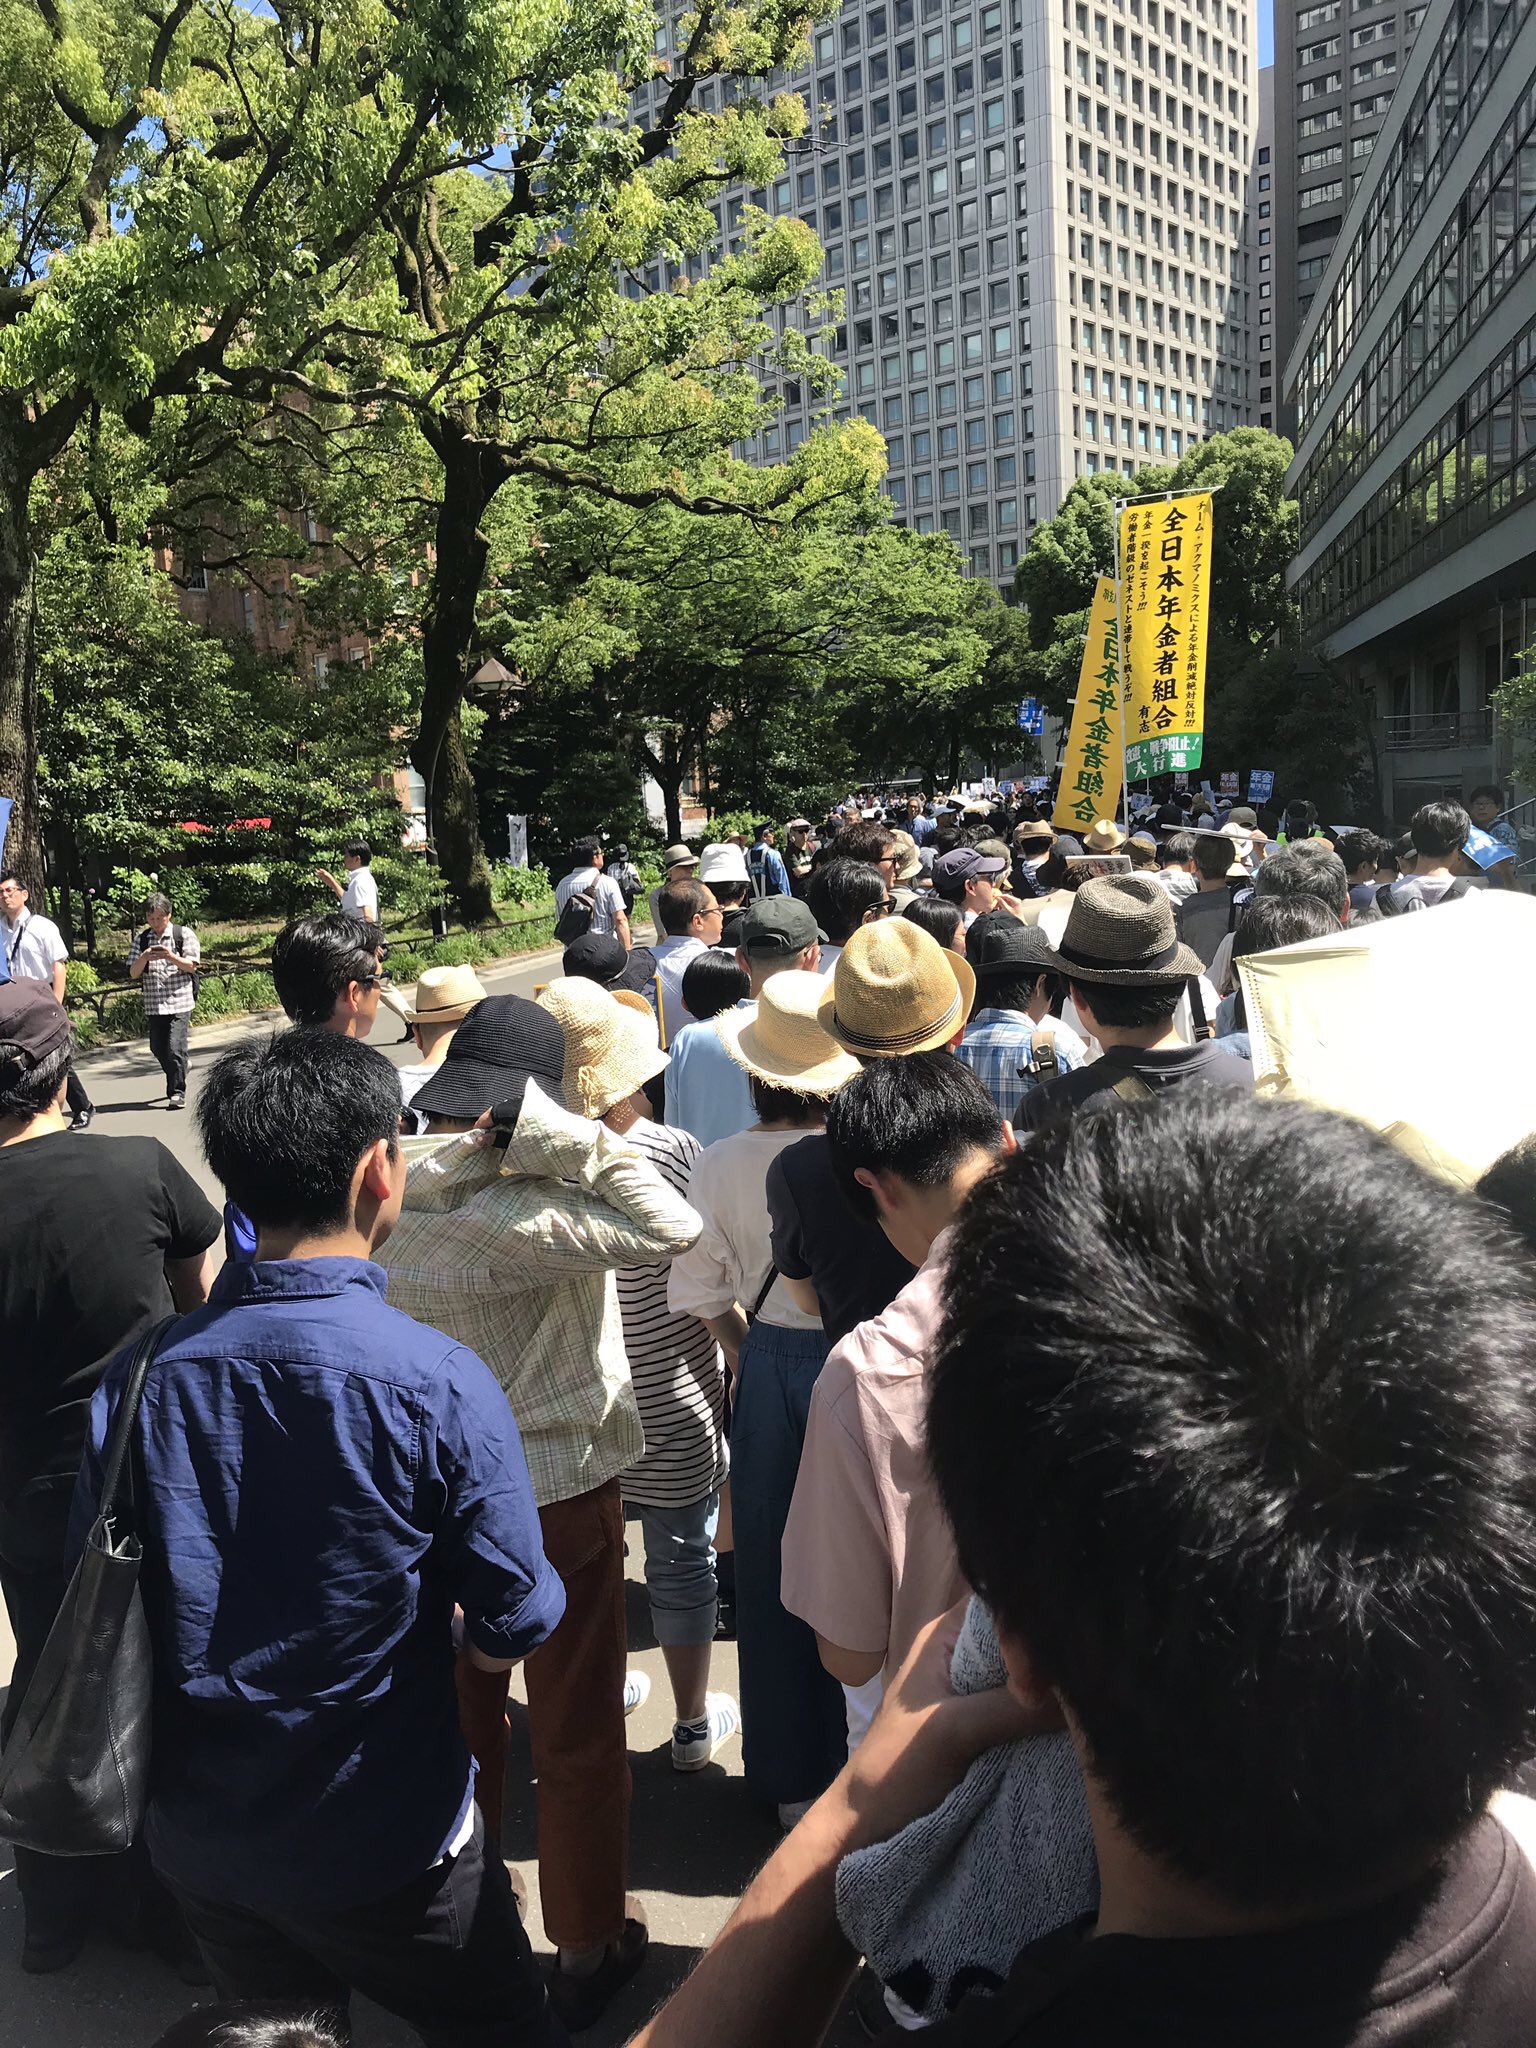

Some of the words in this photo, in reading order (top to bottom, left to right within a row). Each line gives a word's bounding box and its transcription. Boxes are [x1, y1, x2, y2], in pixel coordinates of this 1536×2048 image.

[1150, 507, 1188, 730] 全日本年金者組合
[1138, 705, 1151, 734] 有志
[1250, 771, 1272, 783] 年金
